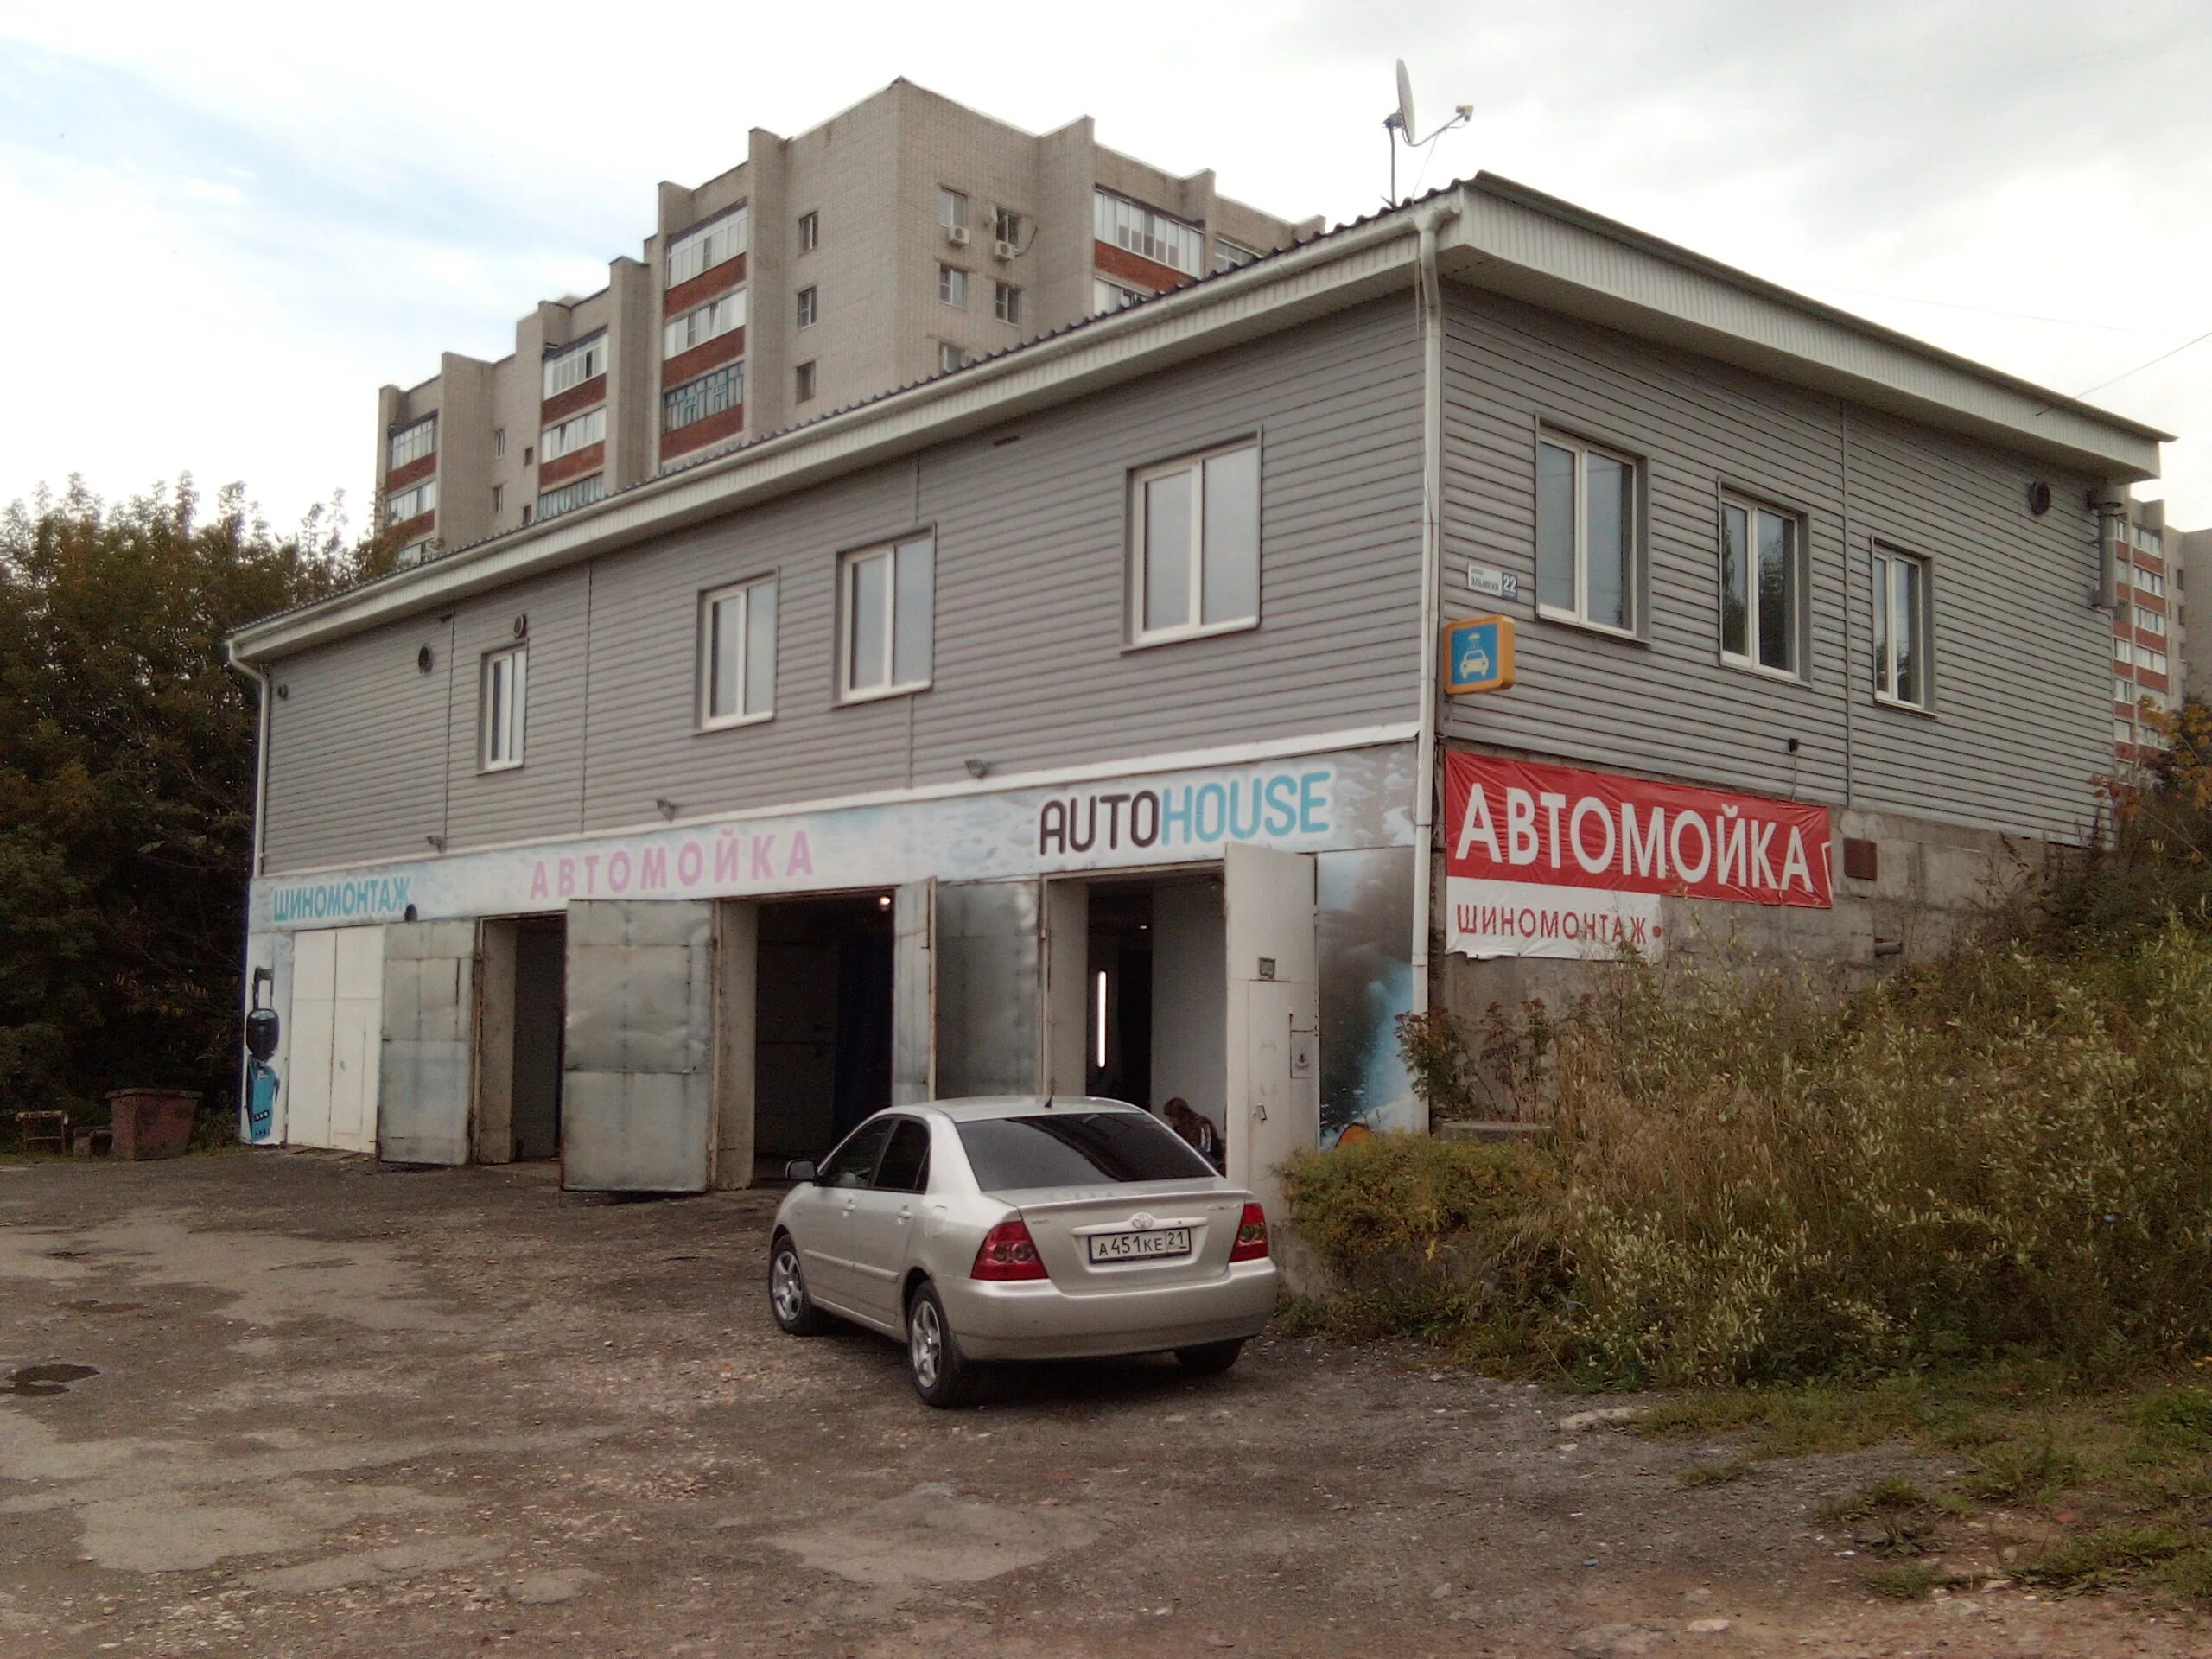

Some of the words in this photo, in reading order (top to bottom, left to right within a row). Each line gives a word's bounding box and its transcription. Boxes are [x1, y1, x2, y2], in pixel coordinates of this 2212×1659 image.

[1503, 575, 1516, 593] 22
[1455, 783, 1814, 893] АВТОМОЙКА
[530, 828, 814, 899] АВТОМОЙКА
[274, 875, 411, 922] ШИНОМОНТАЖ
[1457, 903, 1647, 944] ШИНОМОНТАЖ
